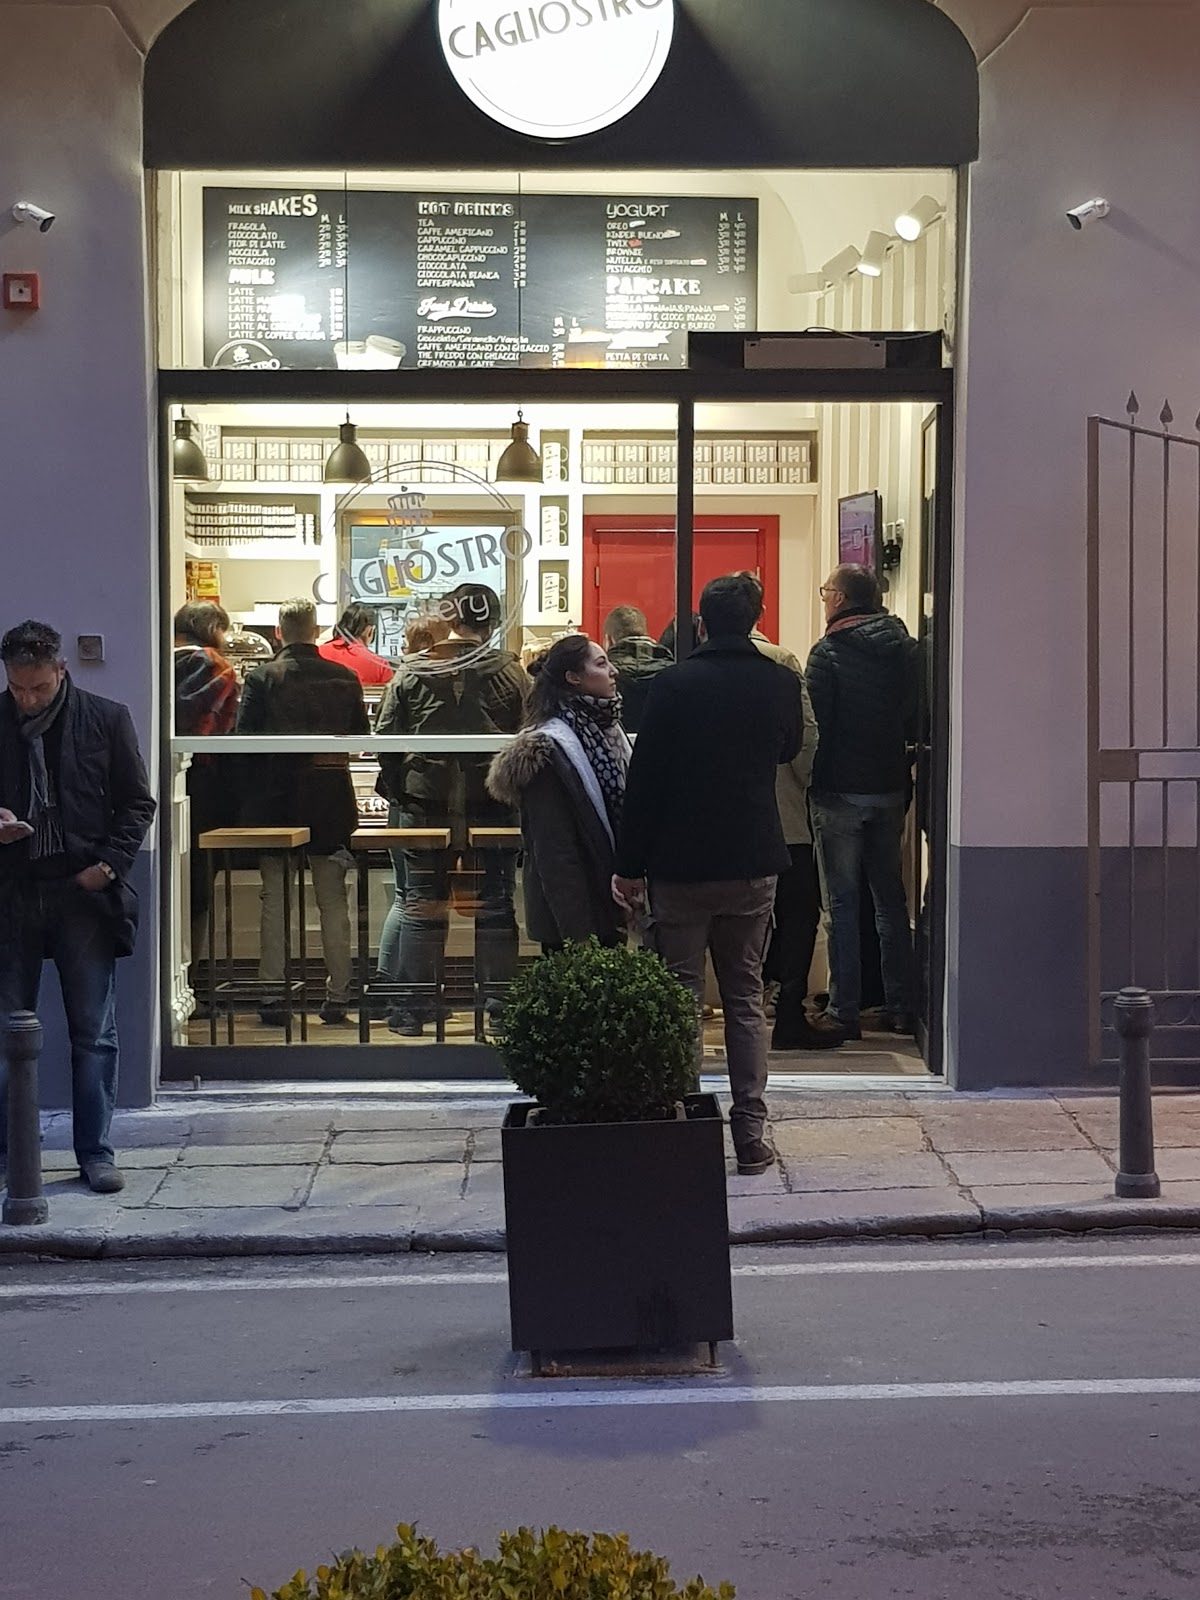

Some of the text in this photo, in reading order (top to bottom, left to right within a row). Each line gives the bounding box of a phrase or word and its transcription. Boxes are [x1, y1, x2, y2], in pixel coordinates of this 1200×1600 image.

[448, 0, 664, 59] CAGLIOSTR
[228, 205, 252, 215] MILK
[418, 201, 515, 217] HOT DRINKS
[606, 204, 669, 219] YOGURT
[321, 214, 330, 223] M
[719, 212, 744, 222] M L
[228, 222, 267, 231] FRAGOLA
[417, 218, 435, 227] TEA
[606, 222, 629, 231] OREO
[444, 228, 494, 237] AMERICANO
[260, 240, 286, 249] LATTE
[606, 239, 629, 248] TWIX
[417, 245, 458, 253] CARAMEL
[606, 256, 642, 265] NUTELLA
[606, 275, 701, 296] PANCAKE
[228, 287, 255, 296] LATTE
[228, 296, 255, 305] LATTE
[228, 305, 255, 314] LATTE
[228, 313, 255, 322] LATTE
[228, 322, 255, 331] LATTE
[228, 331, 255, 339] LATTE
[444, 343, 492, 352] AMERICANO
[311, 525, 533, 606] CAGLIOSTRO
[379, 593, 490, 636] Baery
